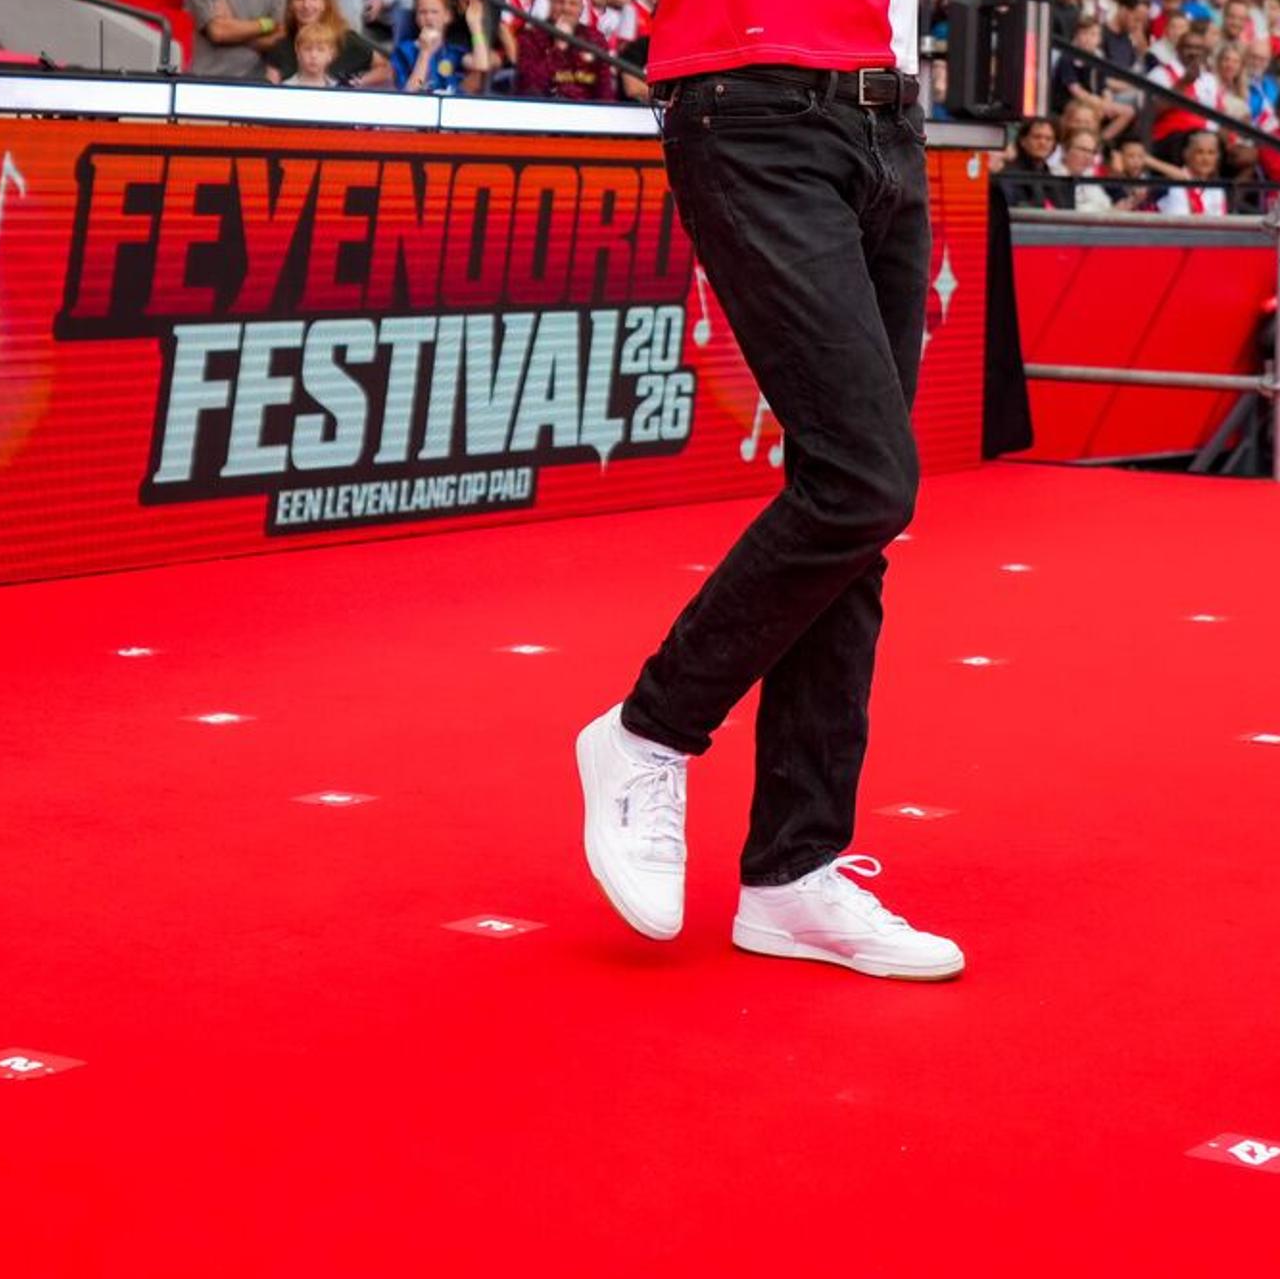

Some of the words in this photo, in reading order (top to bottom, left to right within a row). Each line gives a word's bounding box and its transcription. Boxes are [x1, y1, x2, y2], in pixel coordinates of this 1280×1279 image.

[70, 154, 694, 320] FEYENOORD
[620, 306, 685, 375] 20
[152, 308, 625, 484] FESTIVAL
[630, 372, 695, 443] 26
[275, 486, 322, 525] EEN
[322, 479, 402, 520] LEVEN
[399, 473, 458, 512] LANG
[458, 470, 490, 505] OP
[488, 466, 534, 502] PAD
